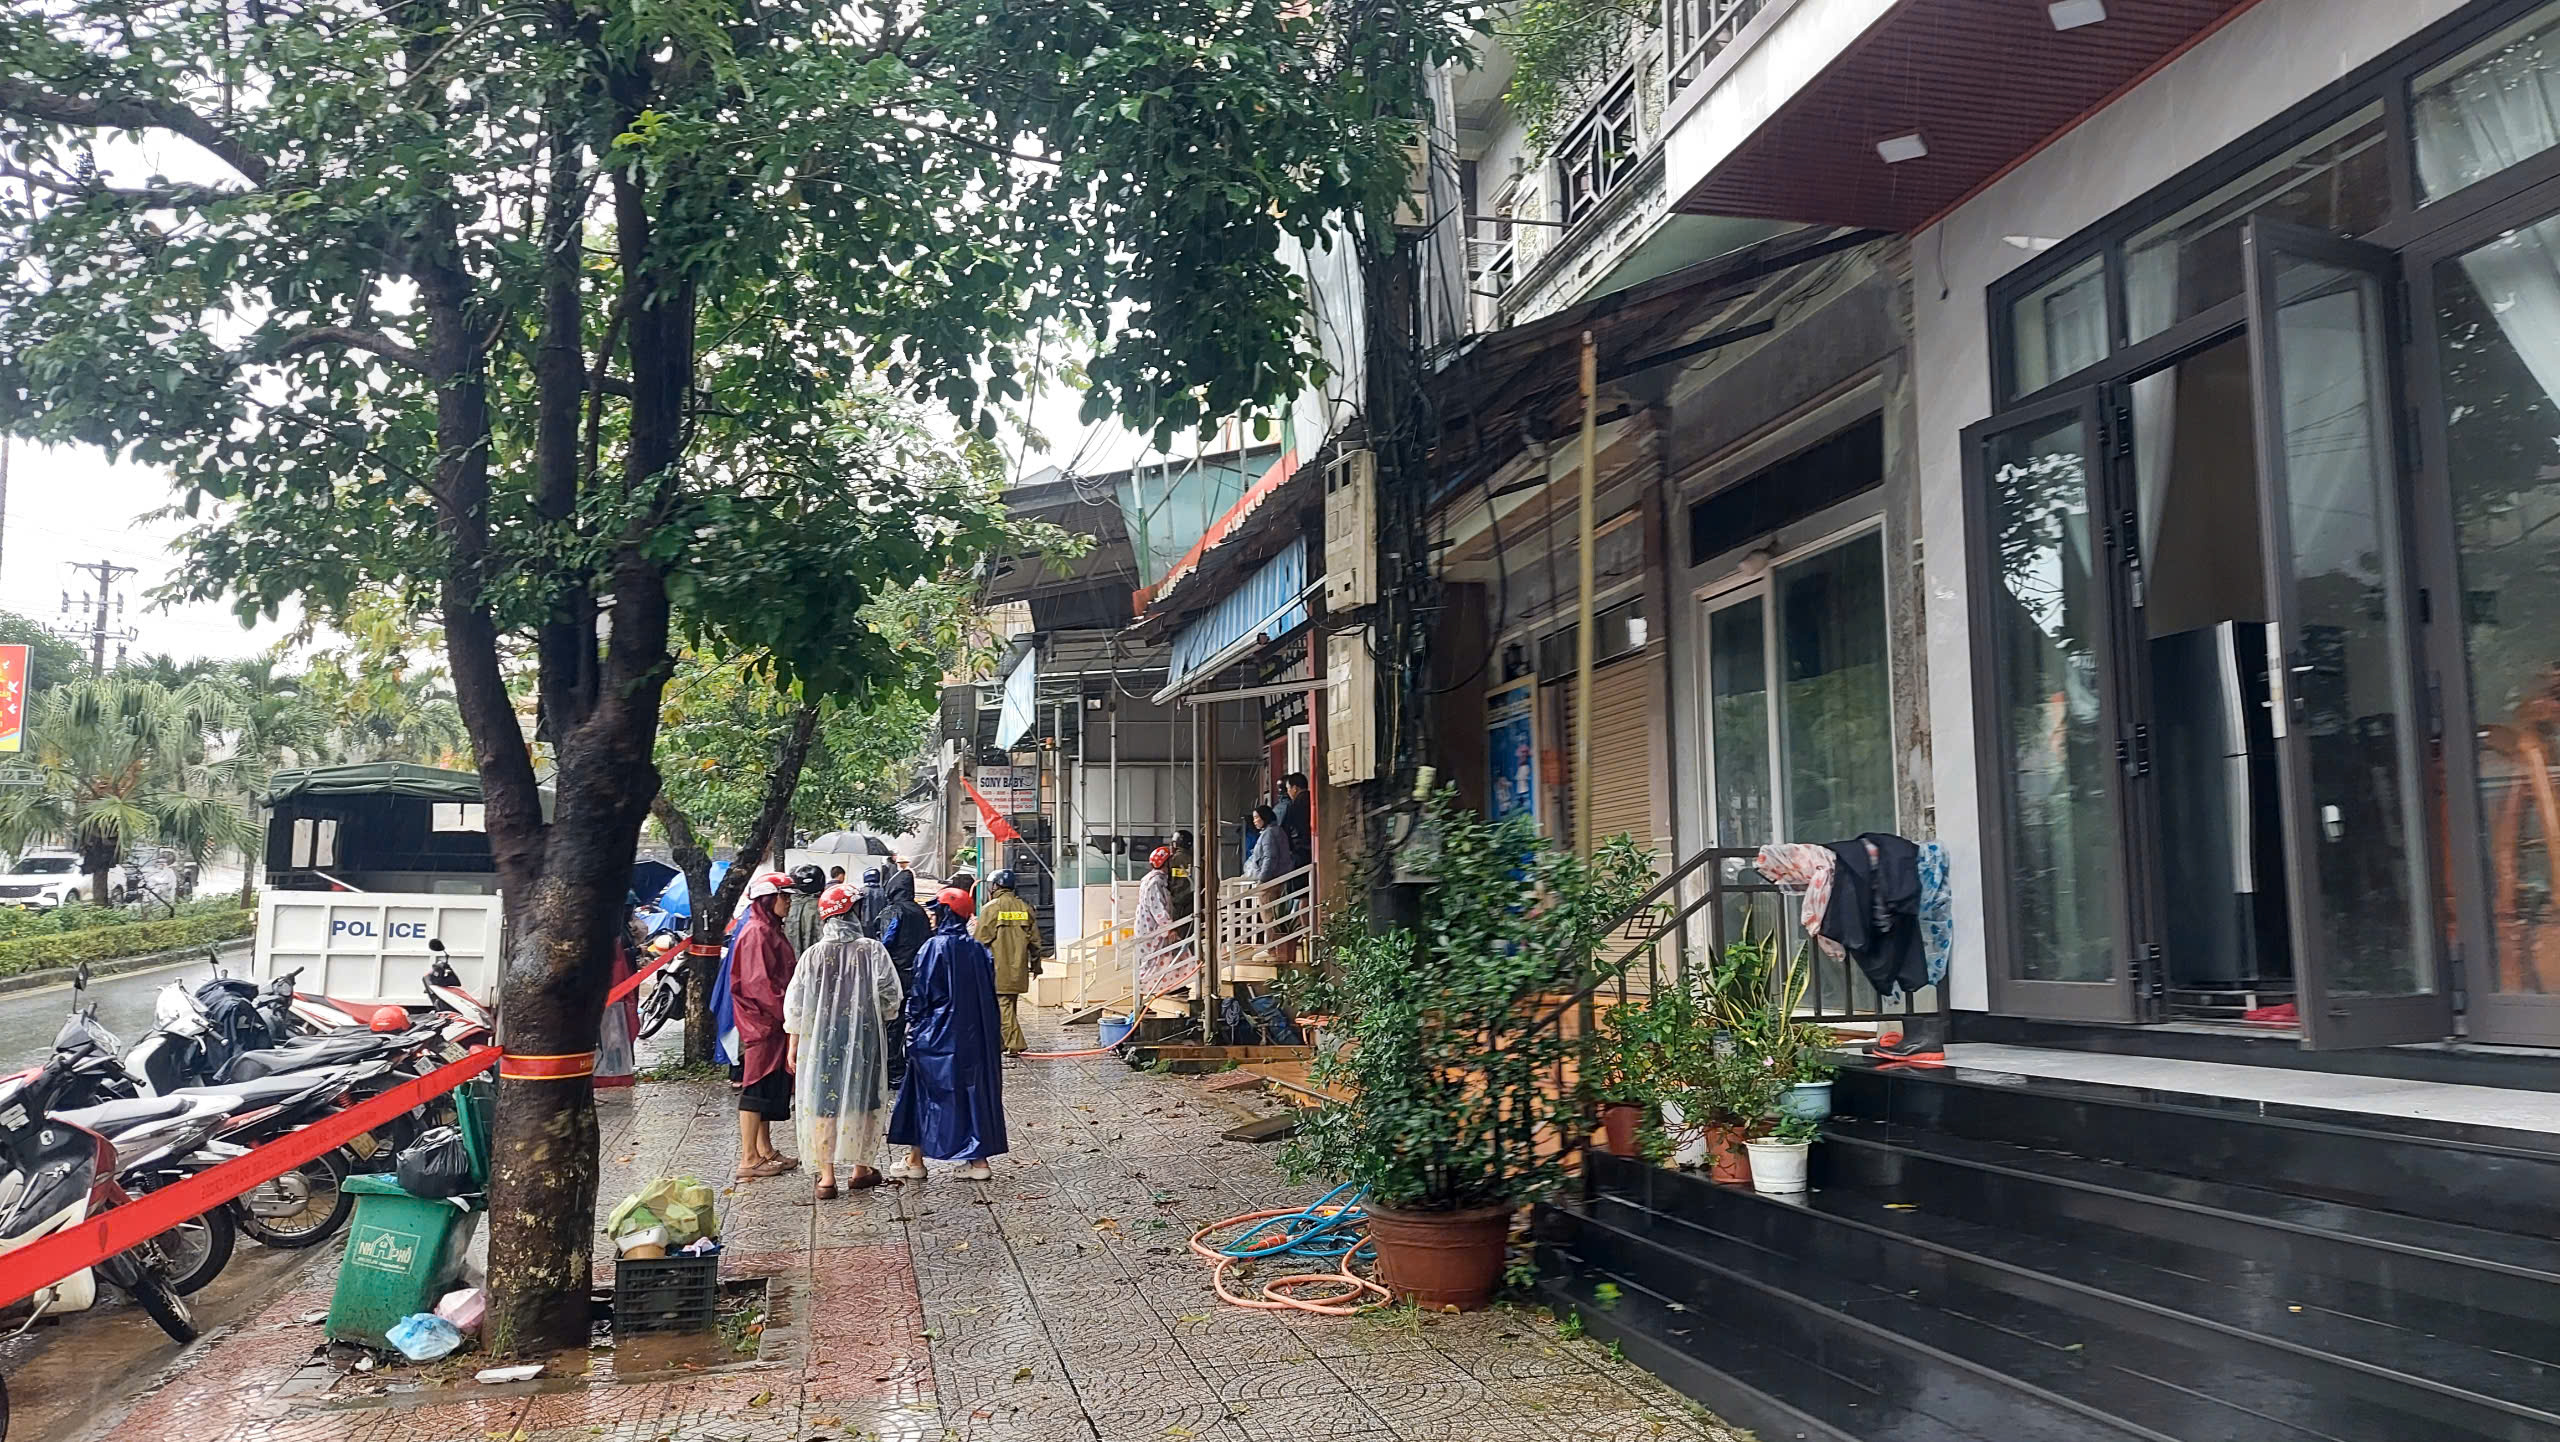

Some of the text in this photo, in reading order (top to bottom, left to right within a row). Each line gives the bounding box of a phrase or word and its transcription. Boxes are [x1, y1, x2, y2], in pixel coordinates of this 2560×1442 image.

[980, 777, 1024, 788] SONY BABY
[331, 920, 427, 939] POLICE
